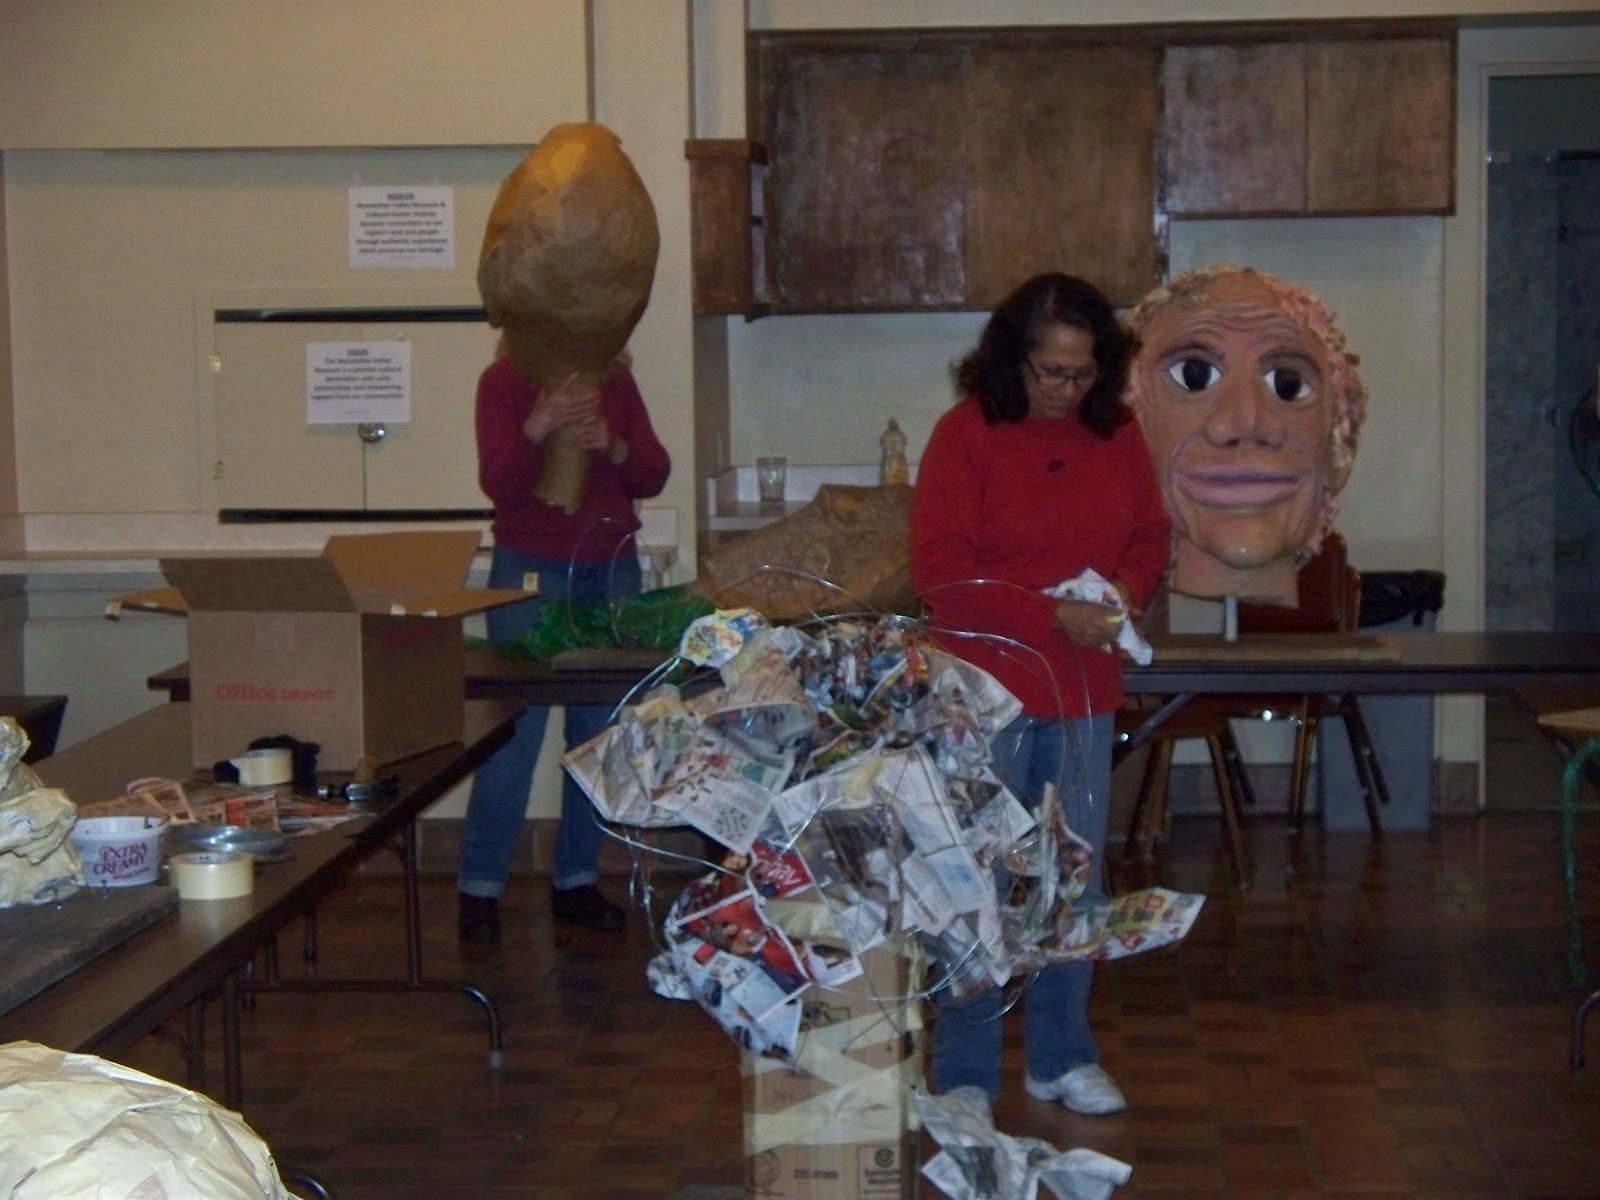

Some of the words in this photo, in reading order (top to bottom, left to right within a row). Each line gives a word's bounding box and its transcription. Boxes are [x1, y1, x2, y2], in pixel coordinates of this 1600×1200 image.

[216, 683, 276, 700] Office
[100, 842, 148, 862] EXTRA
[93, 855, 145, 875] CREAMY
